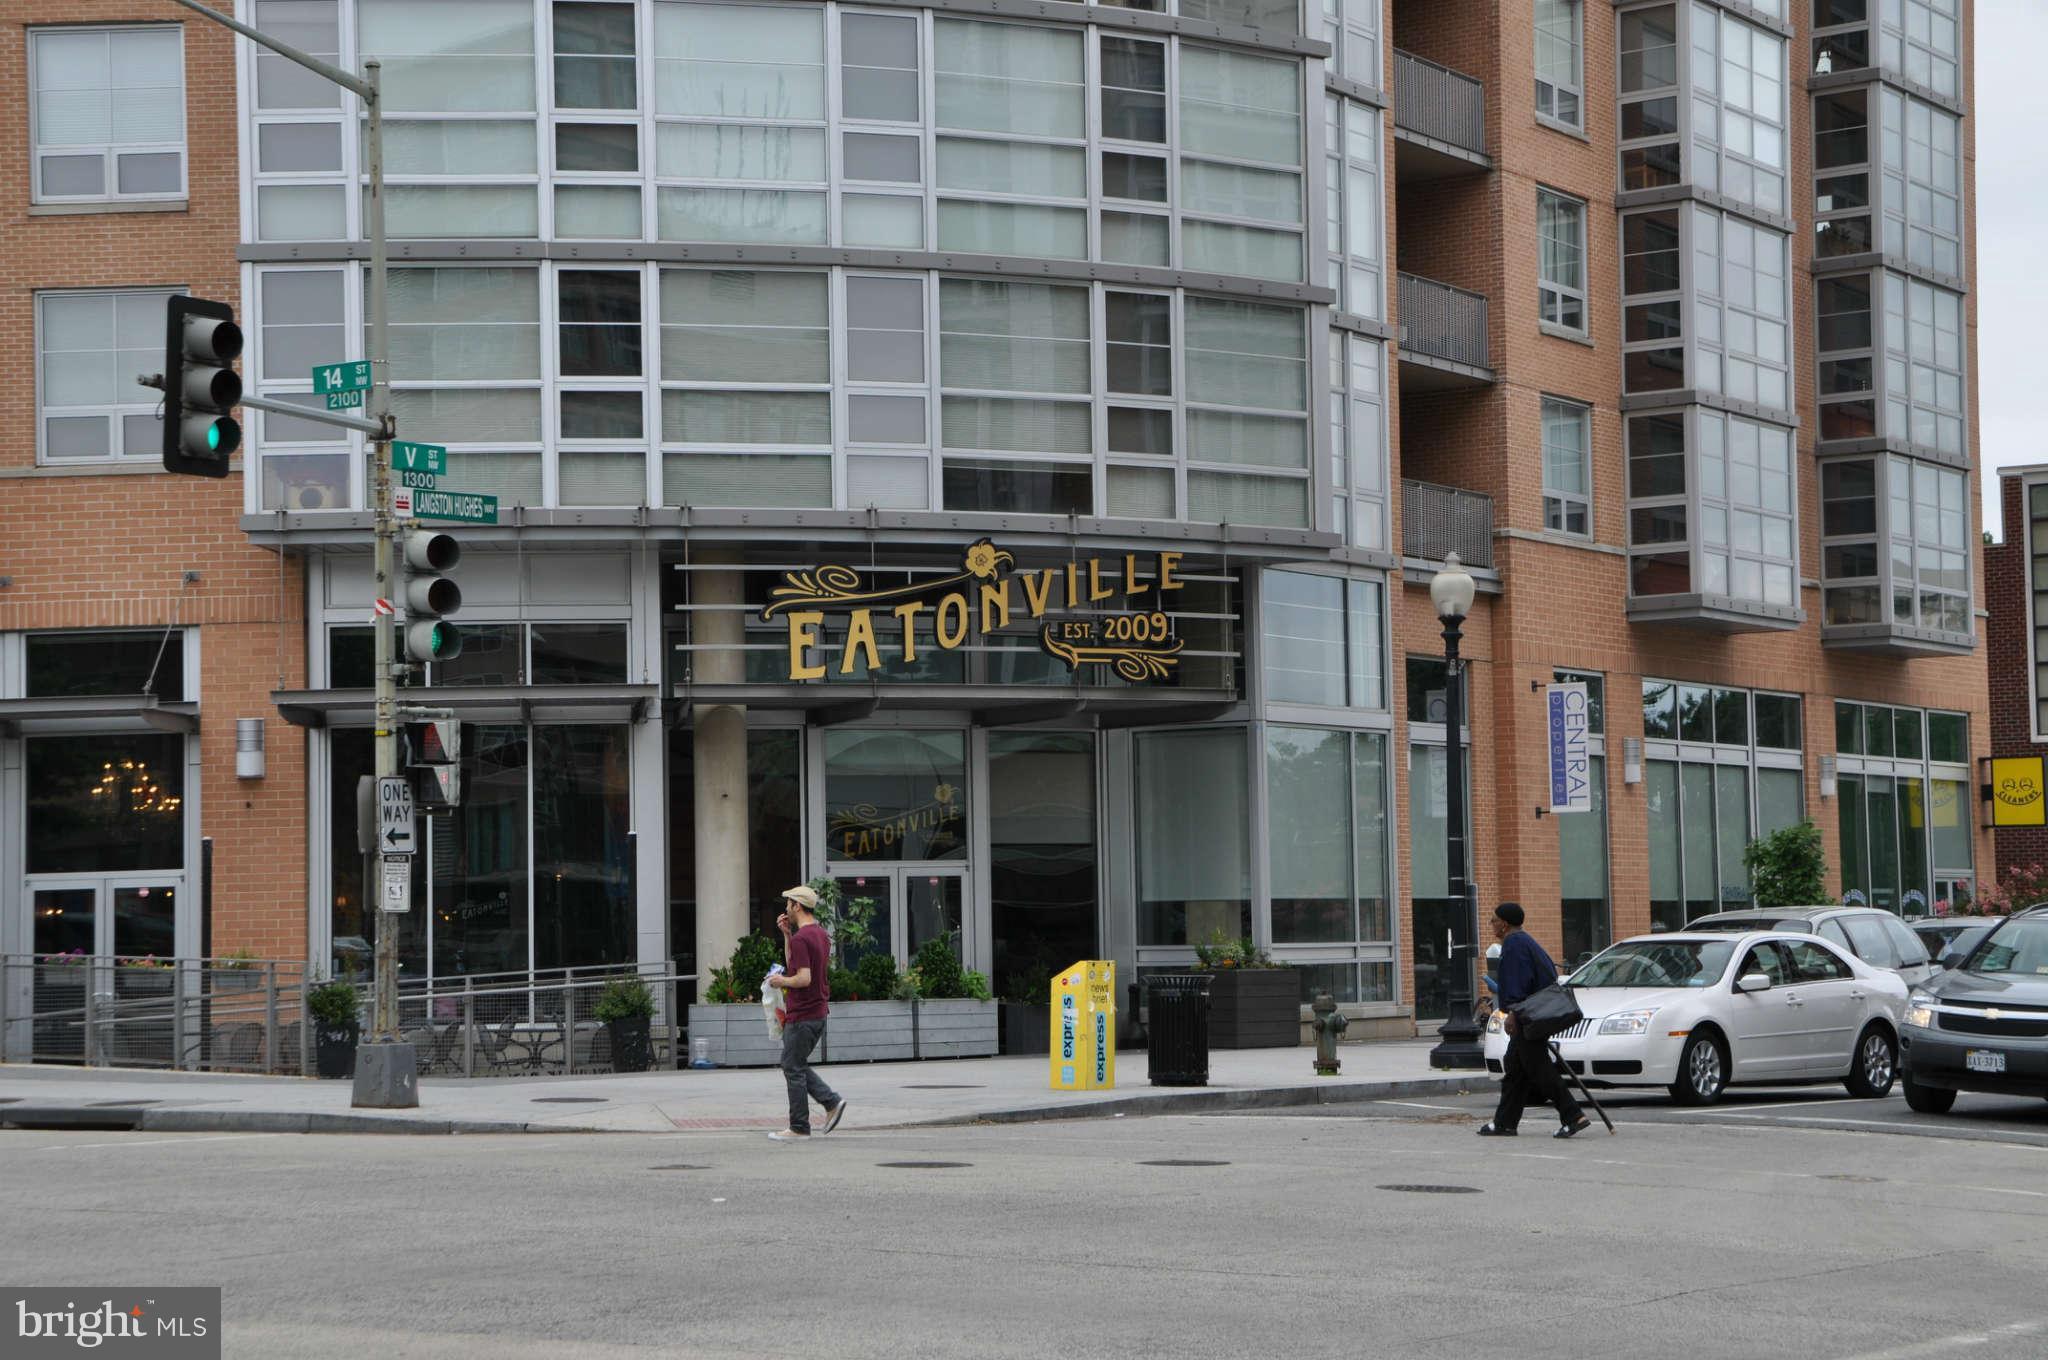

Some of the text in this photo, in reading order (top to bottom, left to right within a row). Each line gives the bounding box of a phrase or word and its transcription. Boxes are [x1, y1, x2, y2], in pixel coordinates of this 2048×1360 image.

[323, 364, 367, 389] 14 ST
[355, 375, 368, 386] NW
[329, 391, 360, 408] 2100
[404, 446, 439, 467] V ST
[427, 459, 440, 471] NW
[403, 471, 434, 488] 1300
[415, 491, 496, 518] LANGSTON HUGHES WAY
[787, 552, 1185, 681] EATONVILLE
[1064, 616, 1168, 643] EST. 2009
[1550, 694, 1566, 805] properties
[1565, 691, 1588, 807] CENTRAL
[383, 783, 411, 801] ONE
[1999, 789, 2039, 804] CLEANERS
[383, 804, 411, 823] WAY
[843, 804, 960, 860] EATONVILLE
[1063, 996, 1074, 1059] exprs
[1096, 1014, 1106, 1082] express
